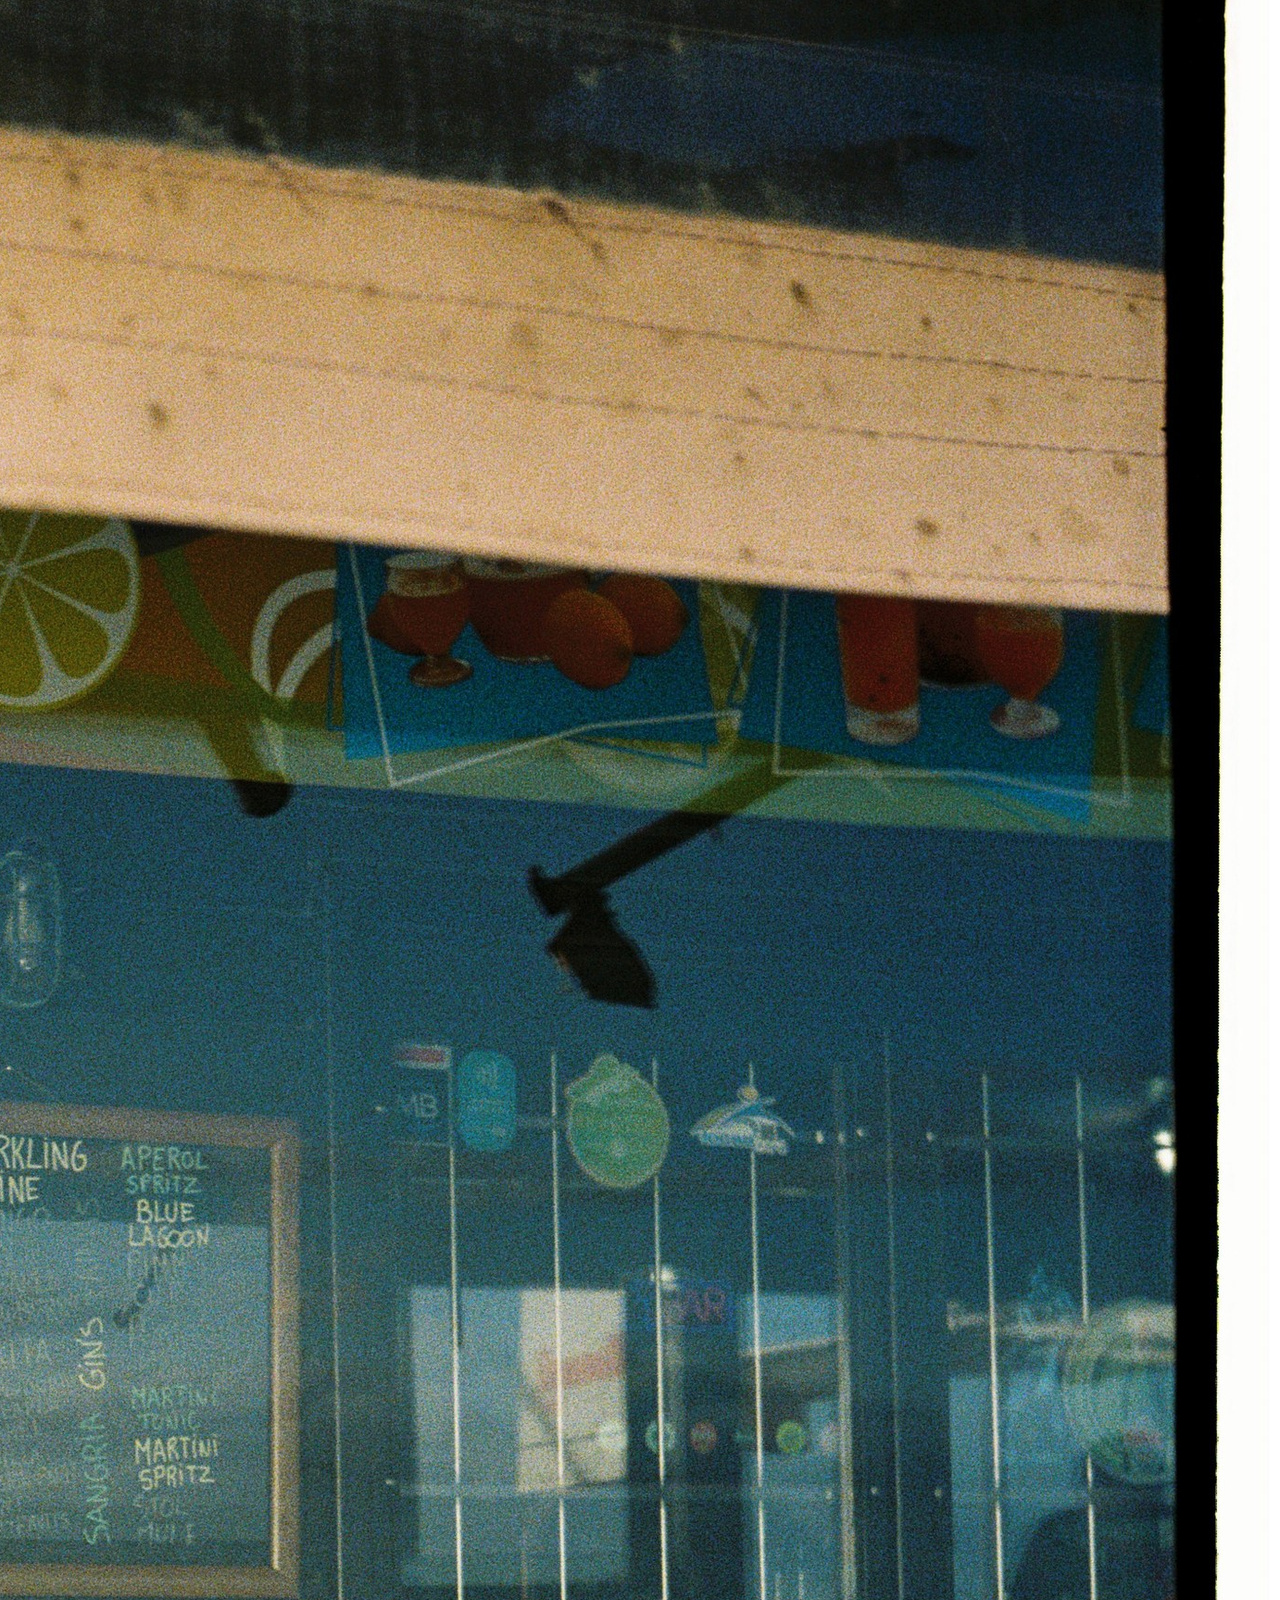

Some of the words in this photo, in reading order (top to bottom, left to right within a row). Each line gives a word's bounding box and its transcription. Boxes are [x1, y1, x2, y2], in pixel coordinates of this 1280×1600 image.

[120, 1145, 209, 1171] APEROL
[126, 1173, 202, 1195] SPRITZ
[136, 1197, 195, 1224] BLUE
[129, 1222, 210, 1249] LAGOON
[133, 1433, 219, 1466] MARTINI
[80, 1412, 112, 1545] SANGRIA
[138, 1463, 216, 1492] SPRITZ
